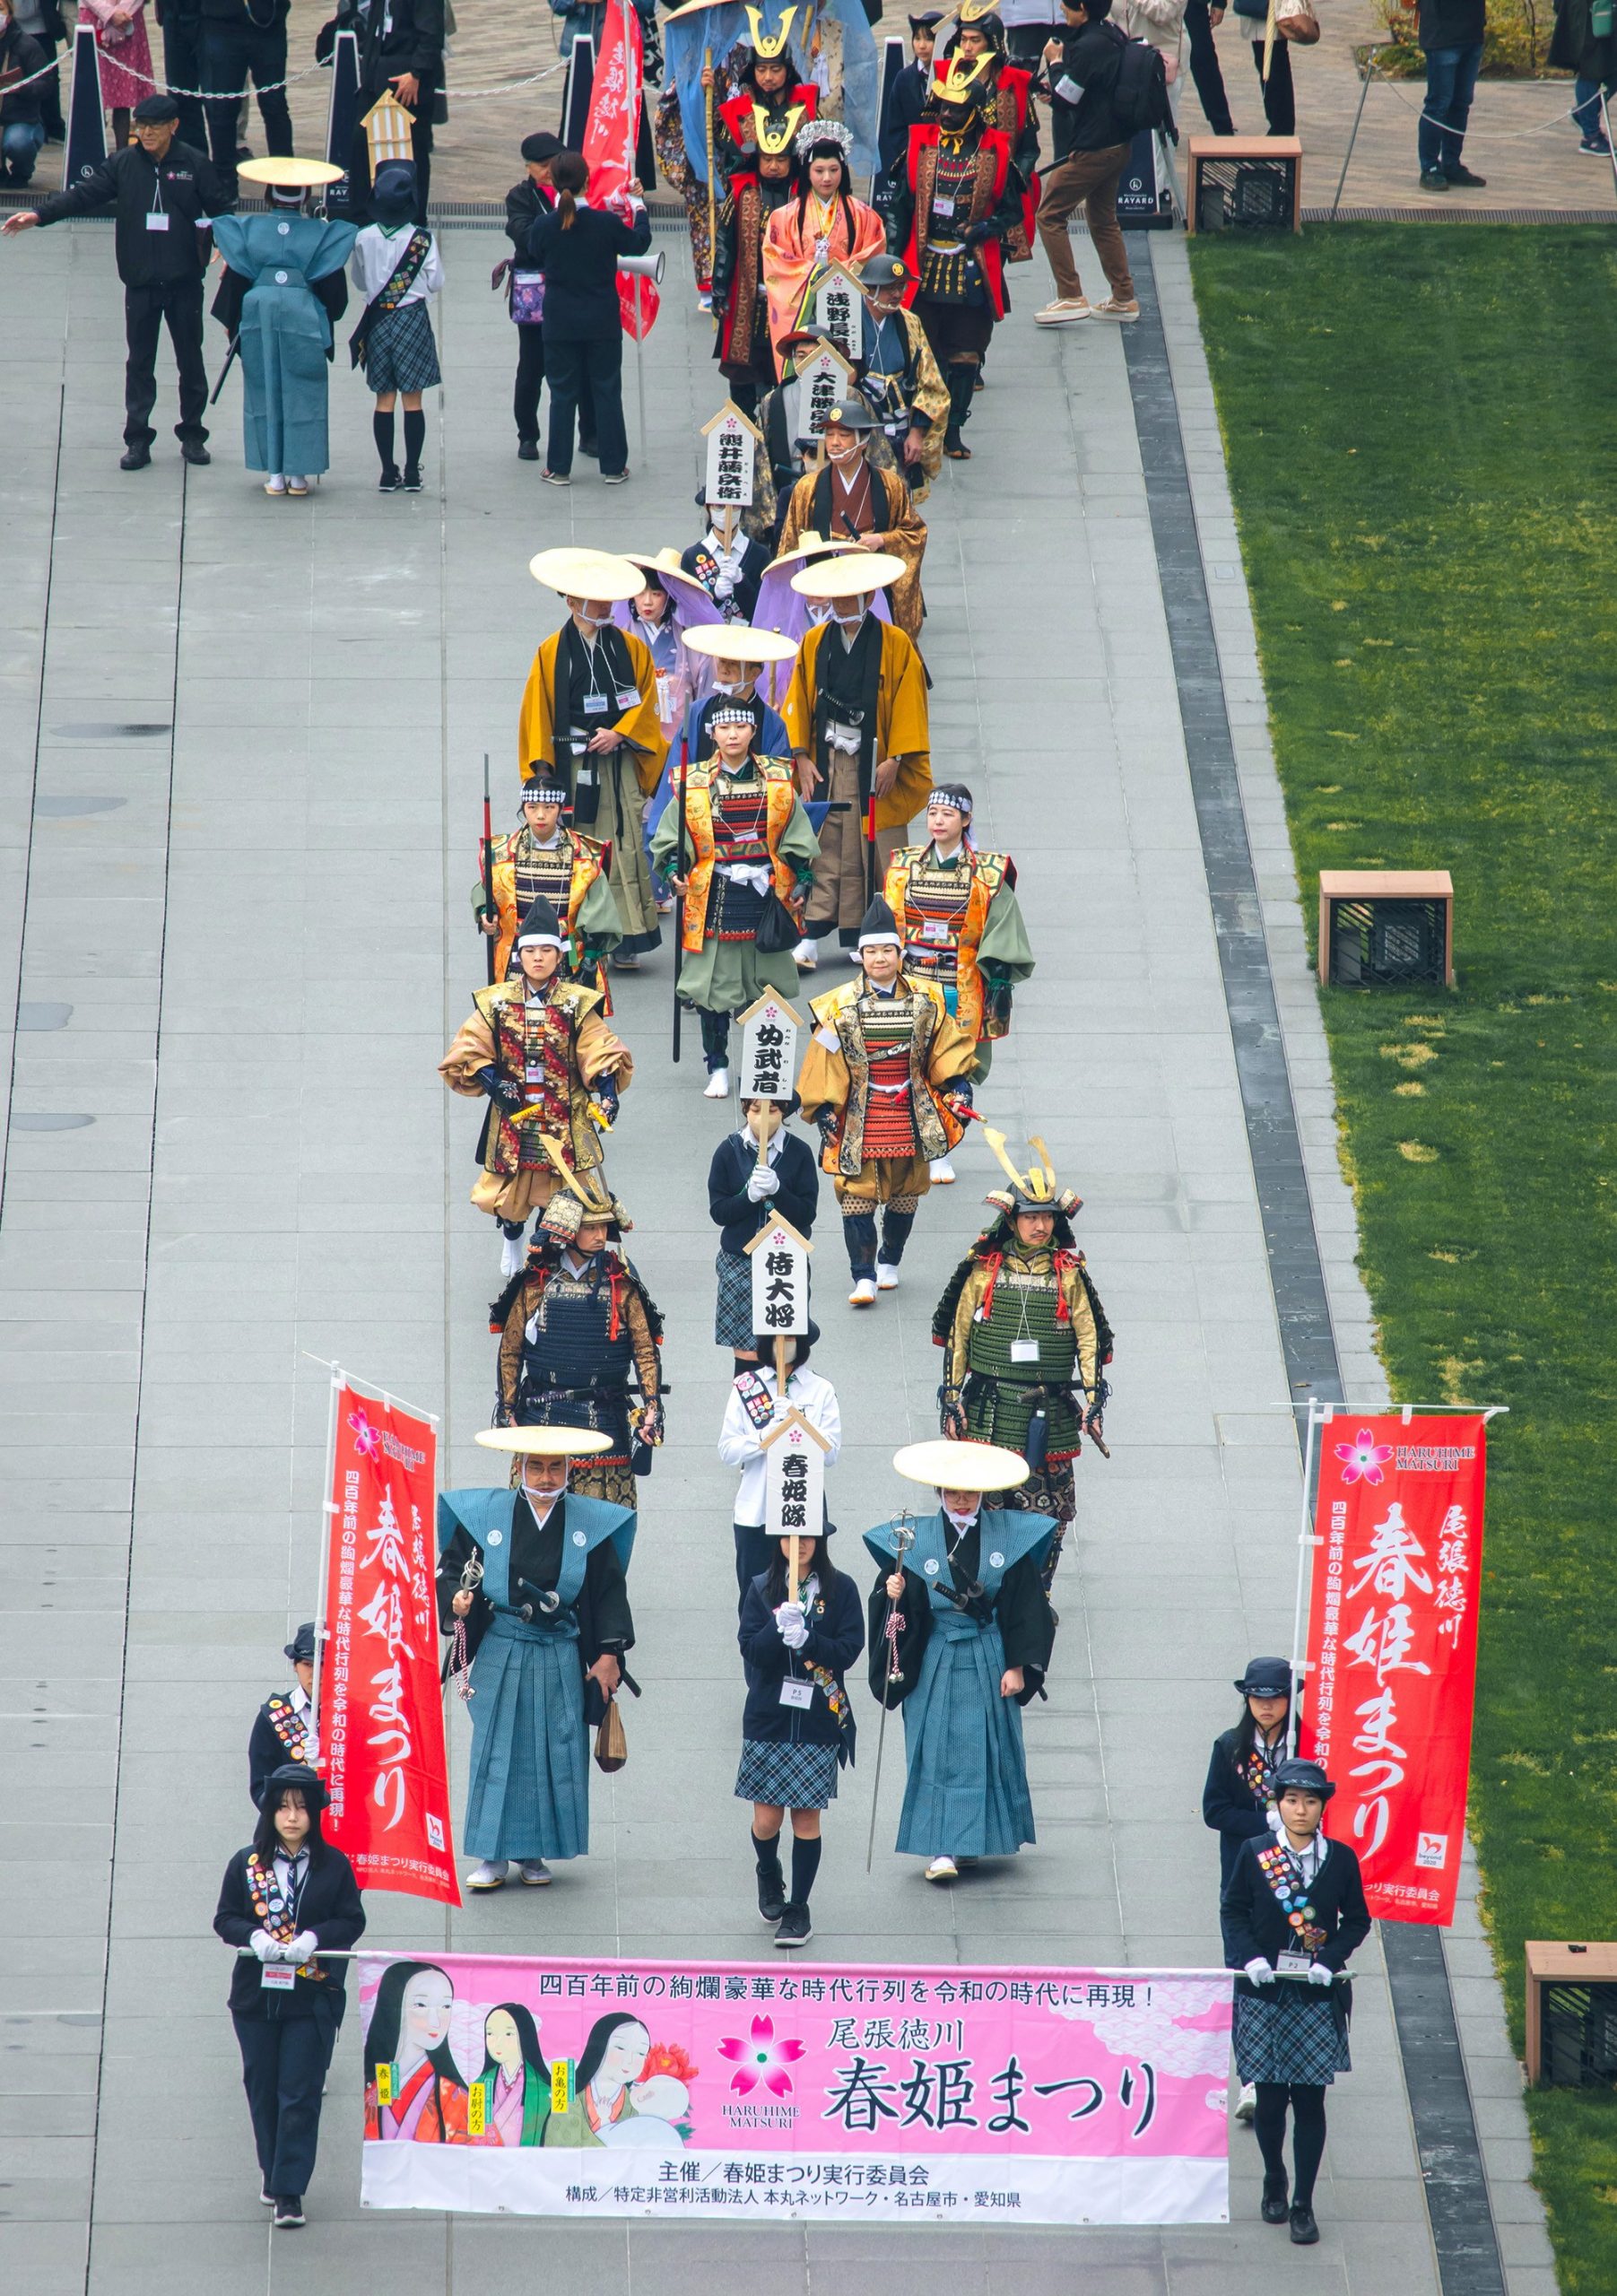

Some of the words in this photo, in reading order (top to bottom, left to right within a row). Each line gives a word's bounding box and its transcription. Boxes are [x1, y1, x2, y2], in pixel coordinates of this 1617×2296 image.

[765, 1251, 795, 1328] 侍大将
[1395, 1458, 1459, 1471] MATSURI
[1396, 1446, 1475, 1459] HARUHIME
[781, 1453, 809, 1527] 春姫隊
[1433, 1504, 1469, 1649] 尾張徳川
[1313, 1500, 1347, 1770] 四百年前の絢爛豪華な時代行列を令和の
[357, 1483, 415, 1832] 春姫まつり
[1343, 1501, 1434, 1863] 春姫まつり
[344, 1853, 449, 1882] ：春姫まつり実行委員会
[1363, 1883, 1440, 1902] つり実行委員会
[539, 1973, 1153, 2008] 四百年前の絢爛豪華な時代行列を令和の時代に再現！
[827, 2017, 964, 2051] 尾張徳川
[378, 2067, 389, 2100] 春姫
[824, 2057, 1154, 2137] 春姫まつり
[722, 2105, 800, 2118] HARUHIME
[729, 2117, 793, 2129] MATSURI
[657, 2160, 930, 2187] 主催／春姫まつり実行委員会
[565, 2186, 760, 2205] 構成／特定非営利活動法人
[763, 2188, 1022, 2209] 本丸ネットワーク・名古屋市・愛知県
